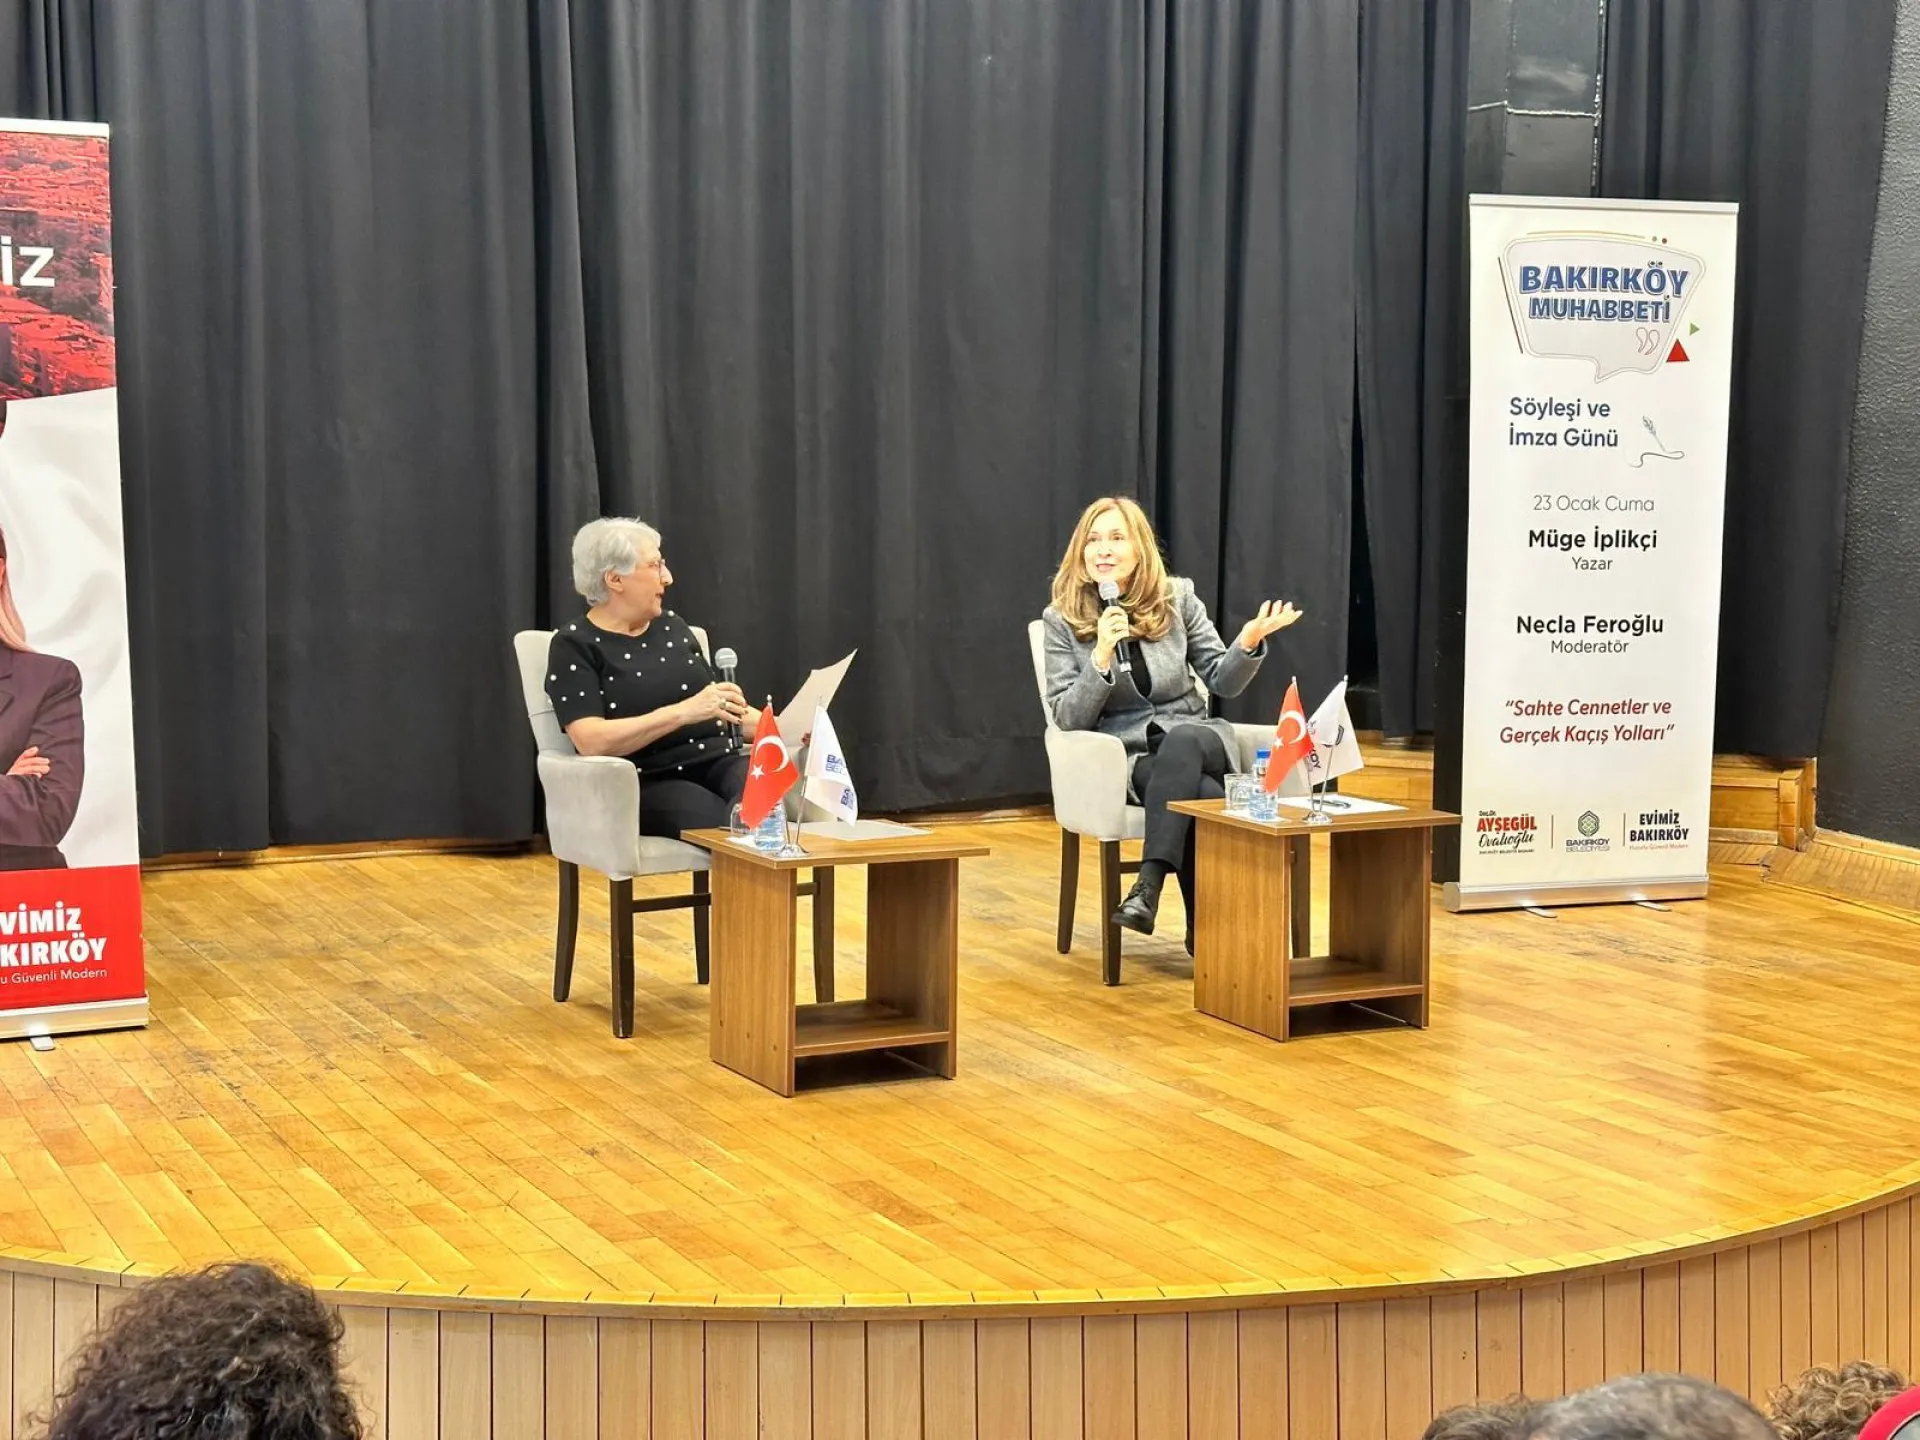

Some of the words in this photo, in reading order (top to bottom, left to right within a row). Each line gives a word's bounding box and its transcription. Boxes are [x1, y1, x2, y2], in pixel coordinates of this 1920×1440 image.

[1519, 260, 1690, 298] BAKIRKÖY
[1529, 295, 1672, 323] MUHABBETİ
[1509, 396, 1581, 423] Söyleşi
[1587, 402, 1611, 418] ve
[1509, 422, 1558, 447] İmza
[1563, 427, 1619, 448] Günü
[1533, 494, 1552, 511] 23
[1556, 494, 1601, 512] Ocak
[1605, 495, 1655, 513] Cuma
[1528, 528, 1586, 552] Müge
[1593, 525, 1657, 552] İplikçi
[1571, 556, 1614, 571] Yazar
[1516, 614, 1576, 635] Necla
[1583, 613, 1664, 637] Feroğlu
[1551, 639, 1630, 654] Moderatör
[1567, 698, 1650, 716] Cennetler
[1652, 701, 1672, 715] ve
[1499, 725, 1561, 746] Gerçek
[1564, 725, 1609, 746] Kaçış
[1476, 813, 1538, 835] AYŞEGÜL
[1639, 808, 1680, 826] EVİMİZ
[1629, 825, 1690, 843] BAKIRKÖY
[11, 969, 57, 984] Güvenli
[60, 968, 108, 980] Modern
